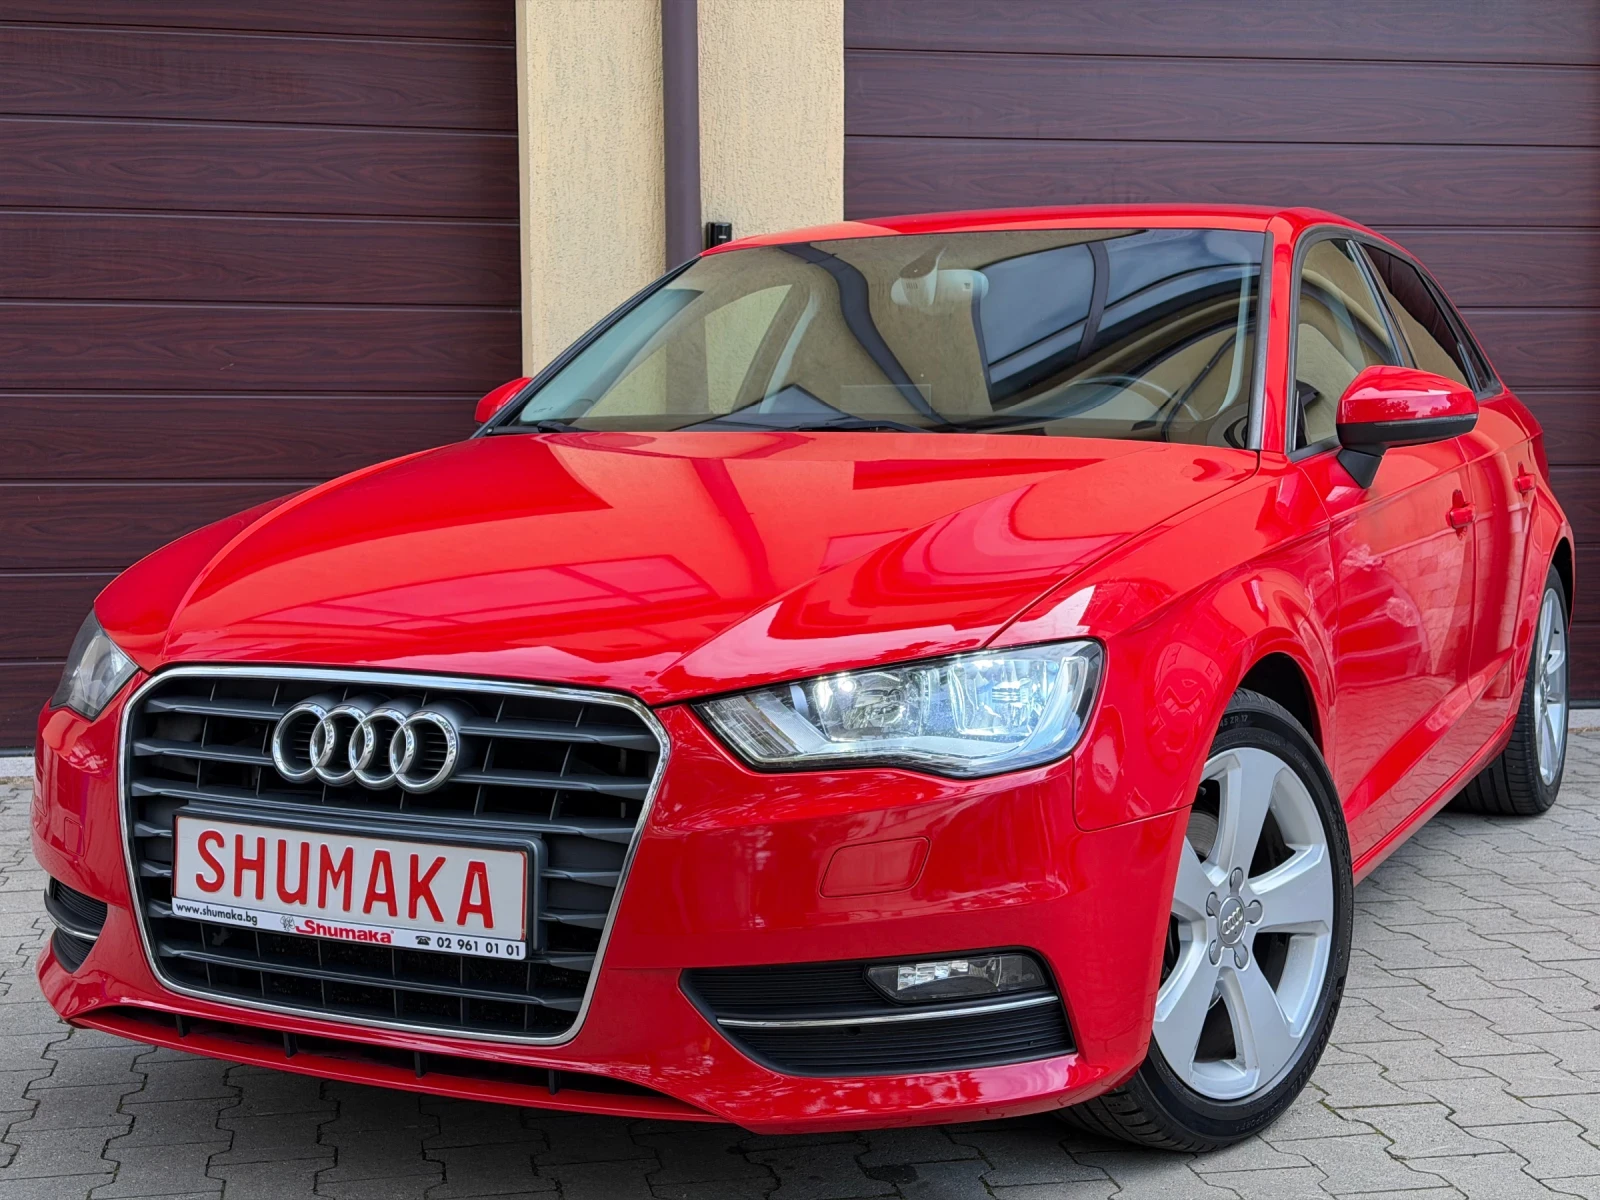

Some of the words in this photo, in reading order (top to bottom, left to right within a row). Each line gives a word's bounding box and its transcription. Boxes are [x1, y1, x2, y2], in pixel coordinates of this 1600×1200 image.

[1241, 714, 1249, 722] 17
[195, 830, 495, 929] SHUMAKA
[175, 902, 258, 926] www.shumaka.bg
[296, 919, 392, 944] Shumaka
[436, 936, 452, 949] 02
[457, 939, 479, 952] 961
[485, 941, 500, 954] 01
[506, 944, 521, 957] 01
[1291, 1006, 1336, 1097] MICHELIN
